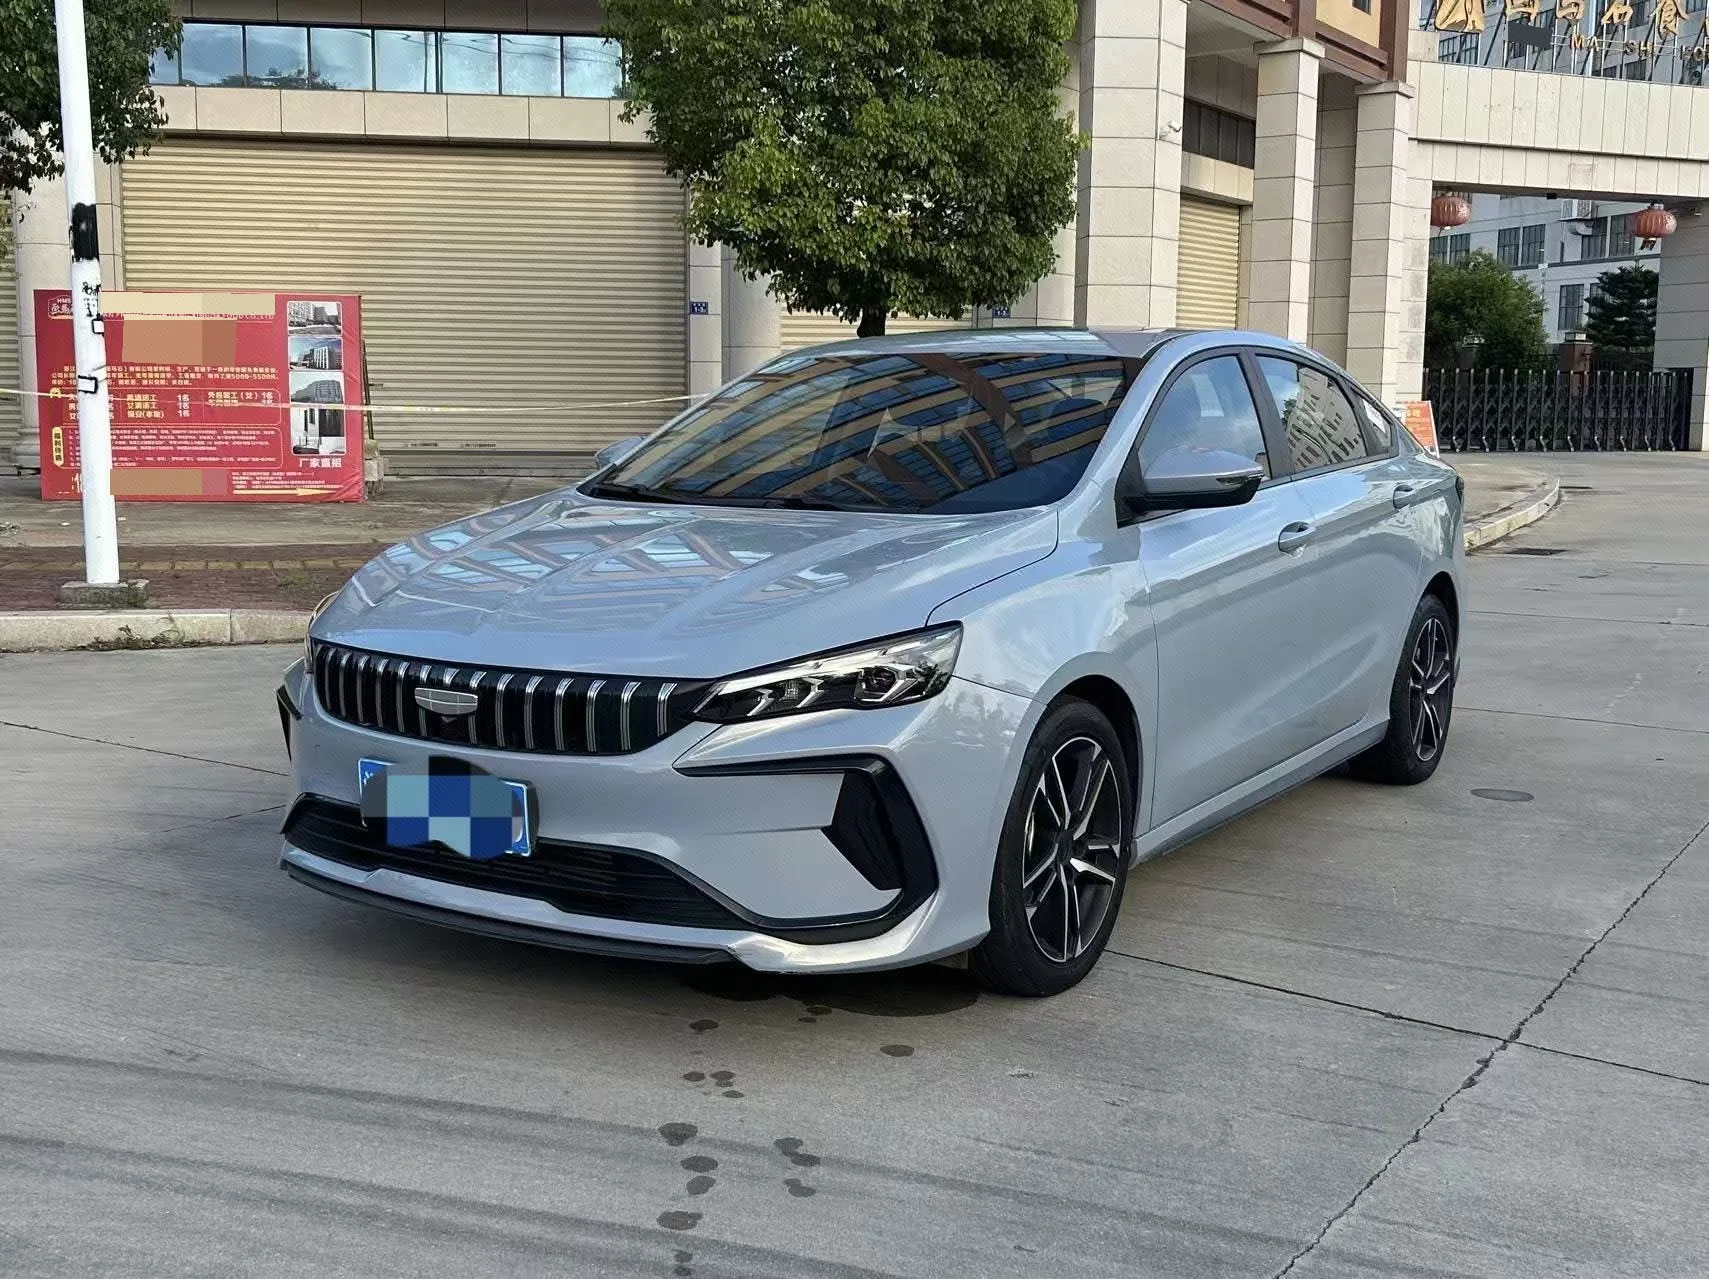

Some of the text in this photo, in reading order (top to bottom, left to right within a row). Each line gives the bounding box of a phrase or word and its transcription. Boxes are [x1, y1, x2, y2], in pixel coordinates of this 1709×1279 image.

[1570, 33, 1599, 51] MA
[298, 457, 342, 468] 厂家直招
